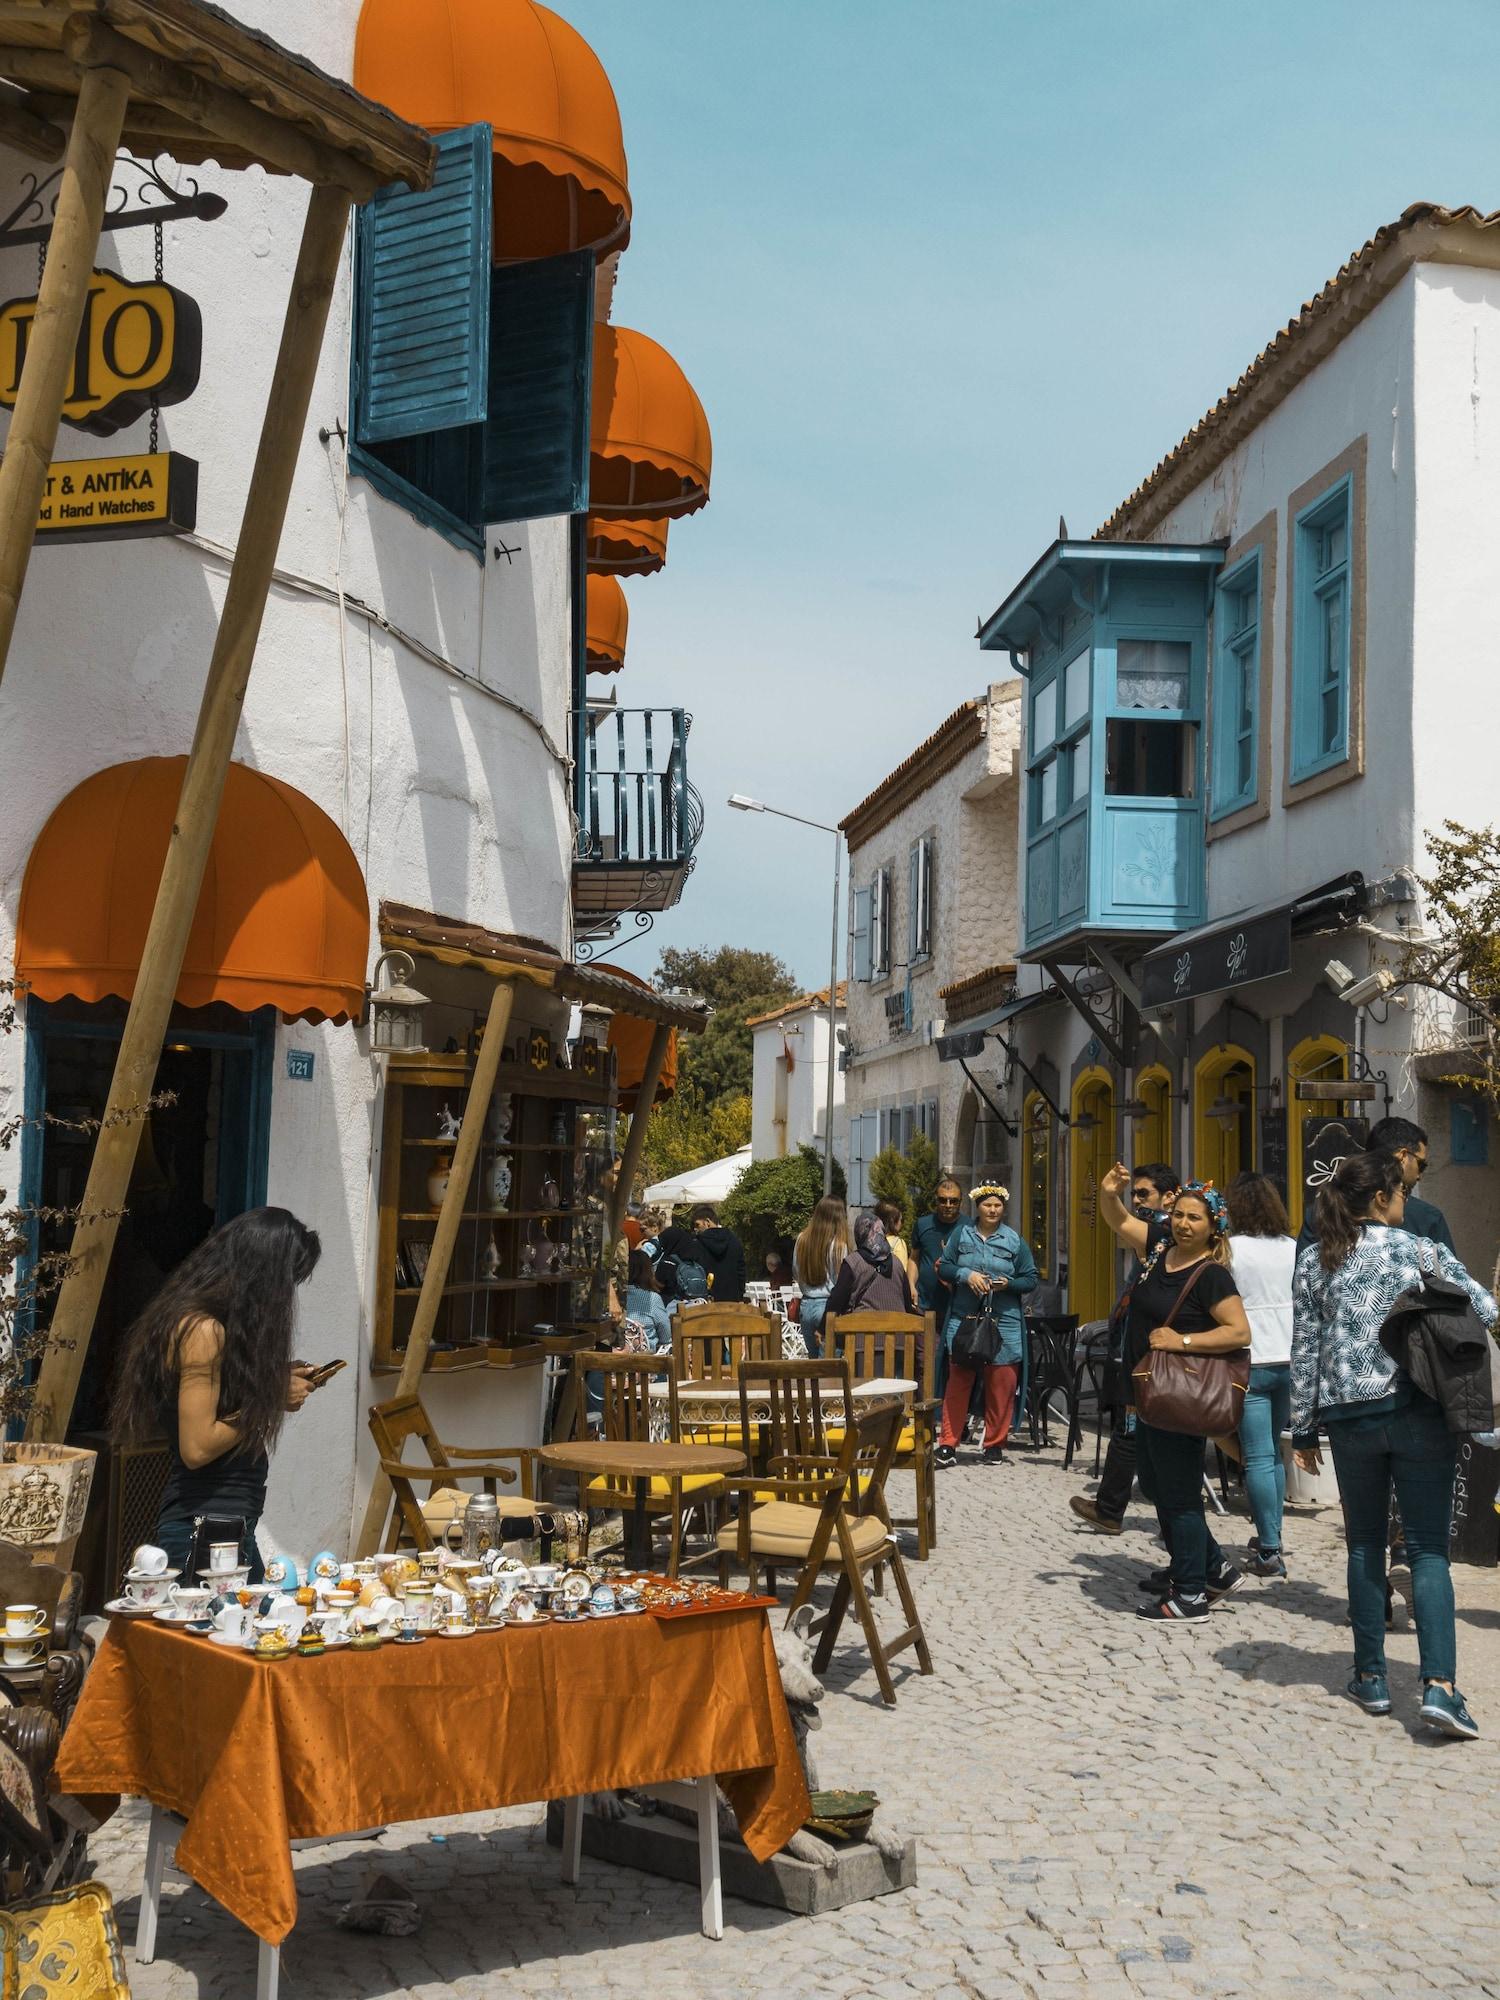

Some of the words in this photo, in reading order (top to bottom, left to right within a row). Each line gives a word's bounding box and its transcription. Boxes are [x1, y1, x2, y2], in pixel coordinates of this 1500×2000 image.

[6, 288, 163, 404] IO
[61, 476, 74, 495] &
[82, 468, 153, 494] ANTİKA
[60, 501, 93, 518] Hand
[99, 498, 155, 516] Watches
[290, 1061, 309, 1076] 121
